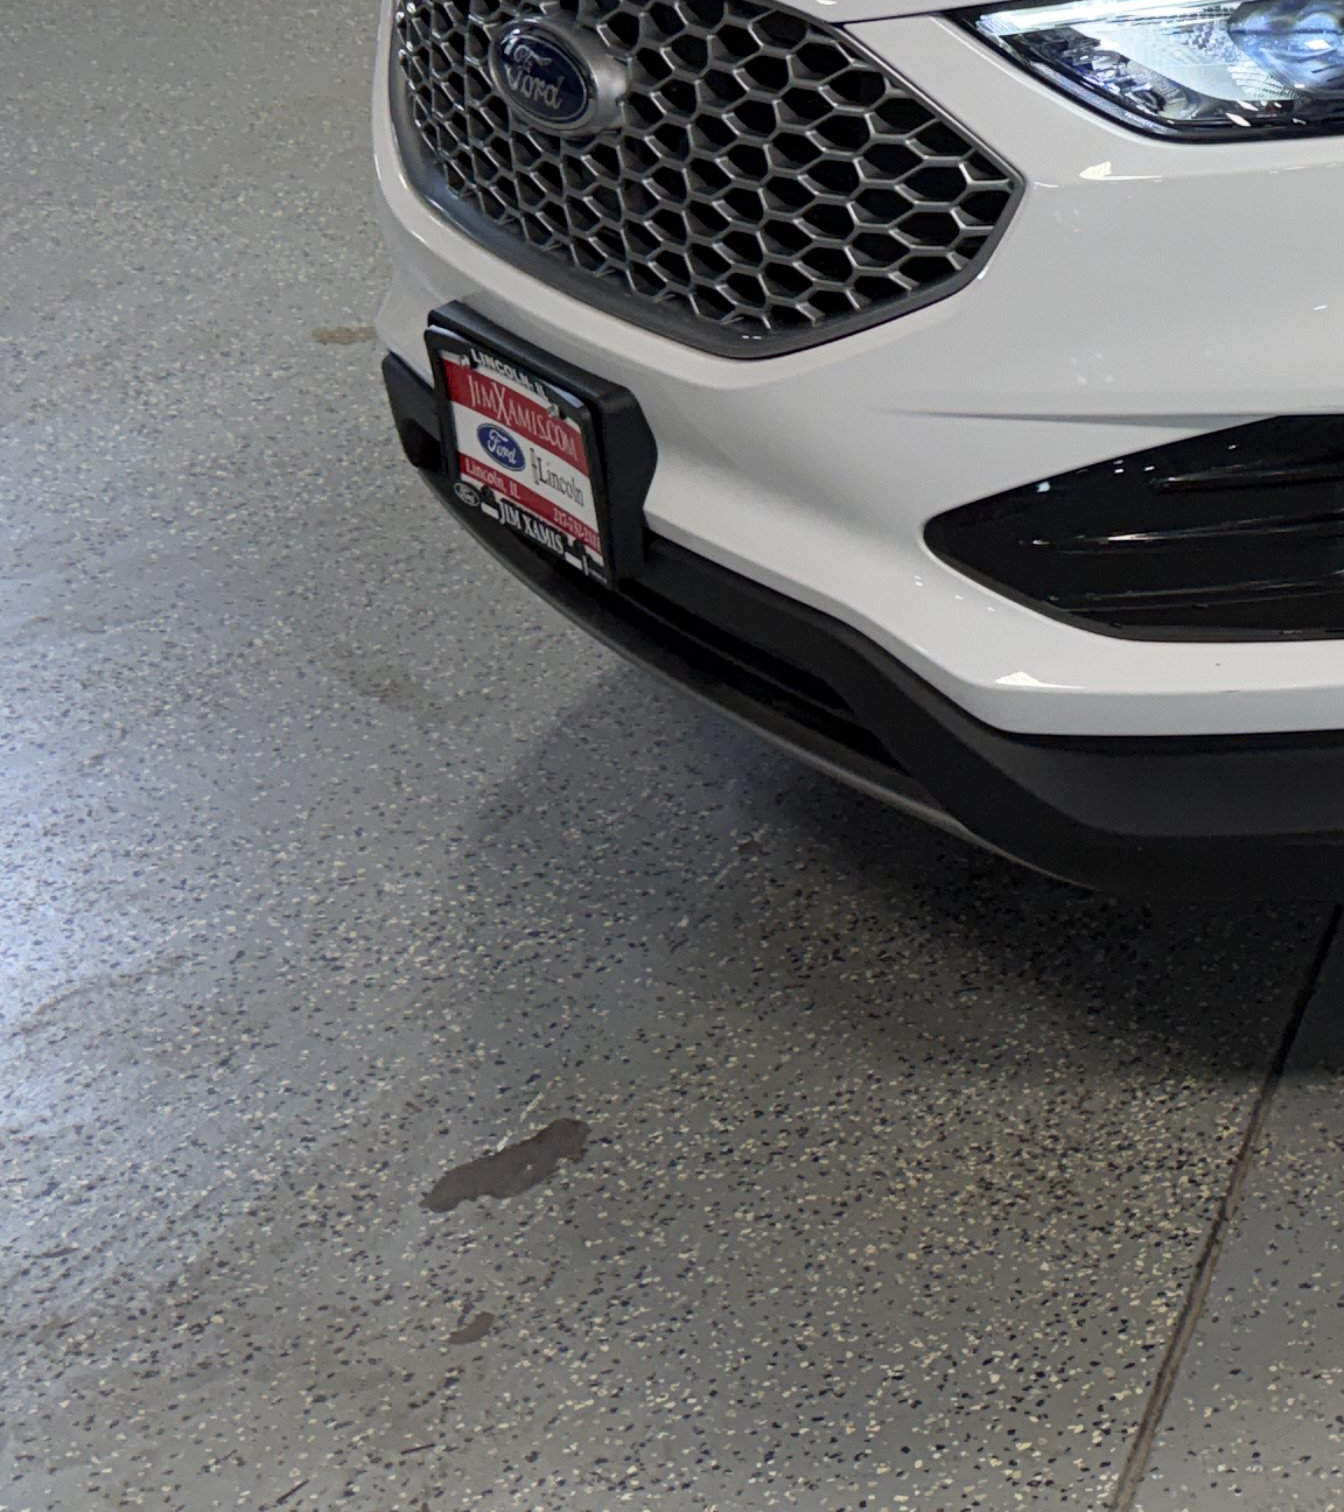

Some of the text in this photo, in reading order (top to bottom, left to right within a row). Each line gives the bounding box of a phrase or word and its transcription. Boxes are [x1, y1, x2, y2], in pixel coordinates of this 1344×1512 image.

[504, 43, 565, 110] Ford
[487, 428, 518, 465] Ford
[537, 456, 585, 507] Lincoln
[499, 501, 565, 555] JIM XAMIS
